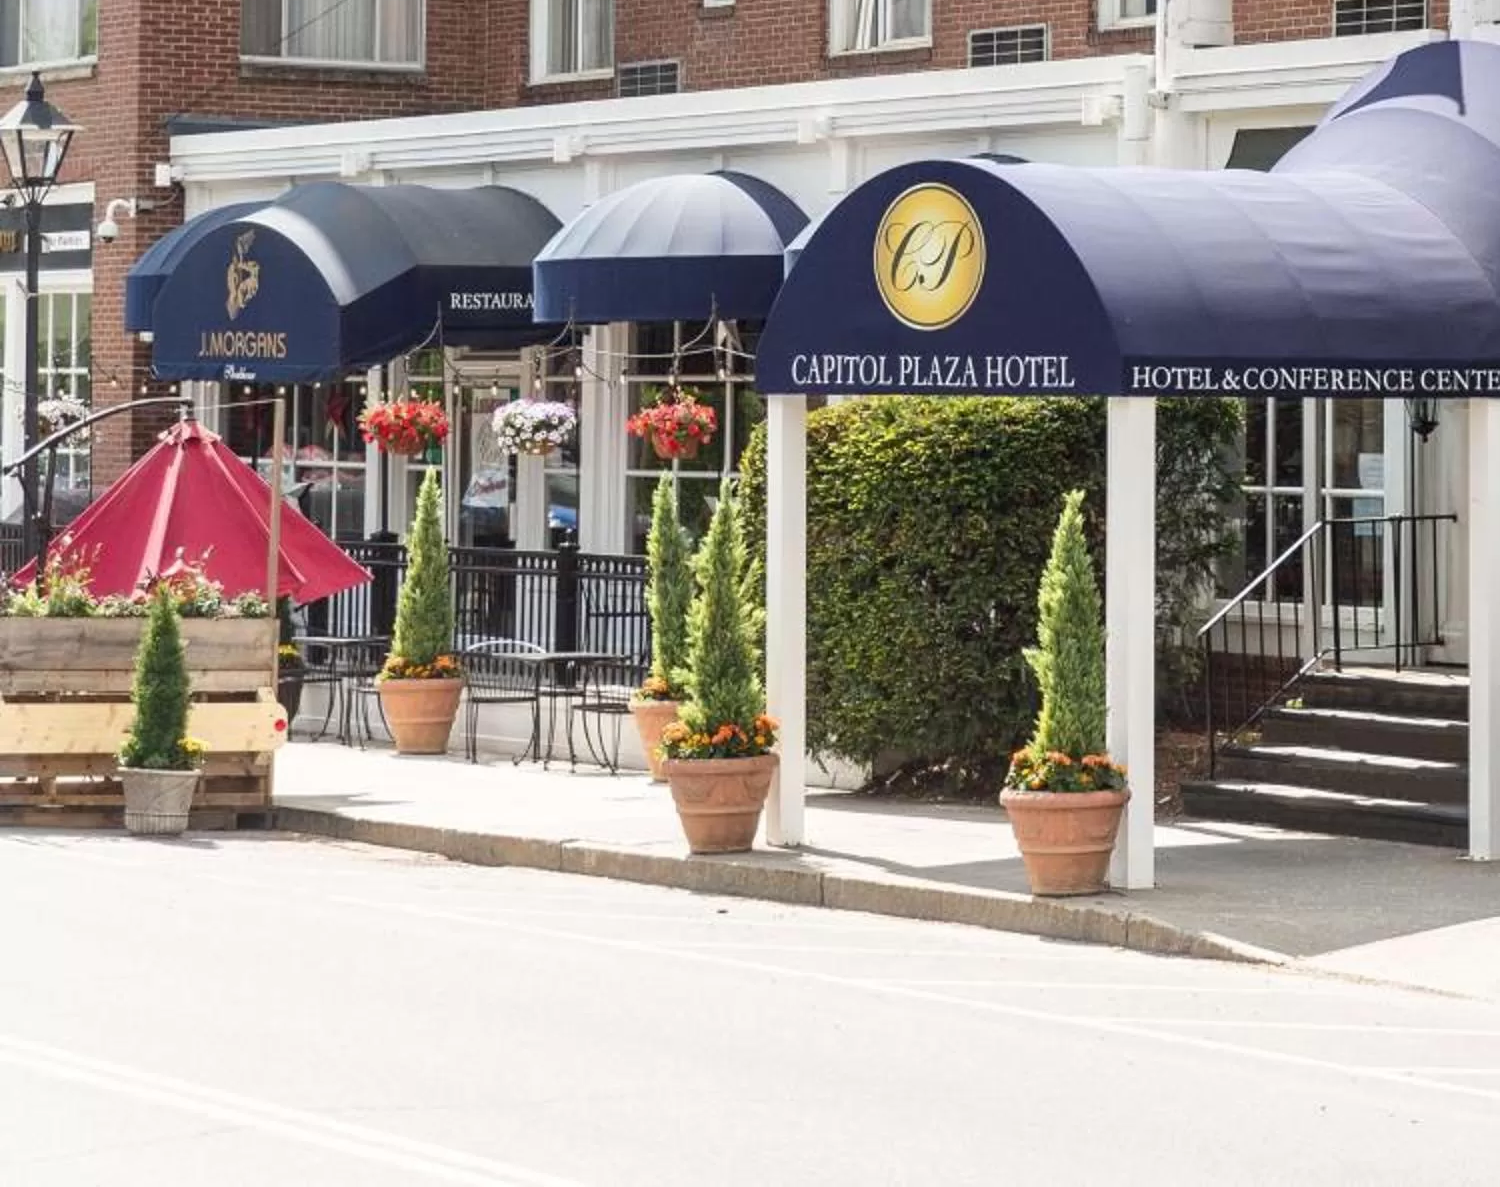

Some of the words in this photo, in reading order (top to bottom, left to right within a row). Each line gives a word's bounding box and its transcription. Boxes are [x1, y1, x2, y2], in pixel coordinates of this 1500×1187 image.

[792, 354, 892, 385] CAPITOL
[899, 355, 978, 387] PLAZA
[984, 356, 1075, 388] HOTEL
[1132, 366, 1218, 390] HOTEL
[1243, 368, 1415, 391] CONFERENCE
